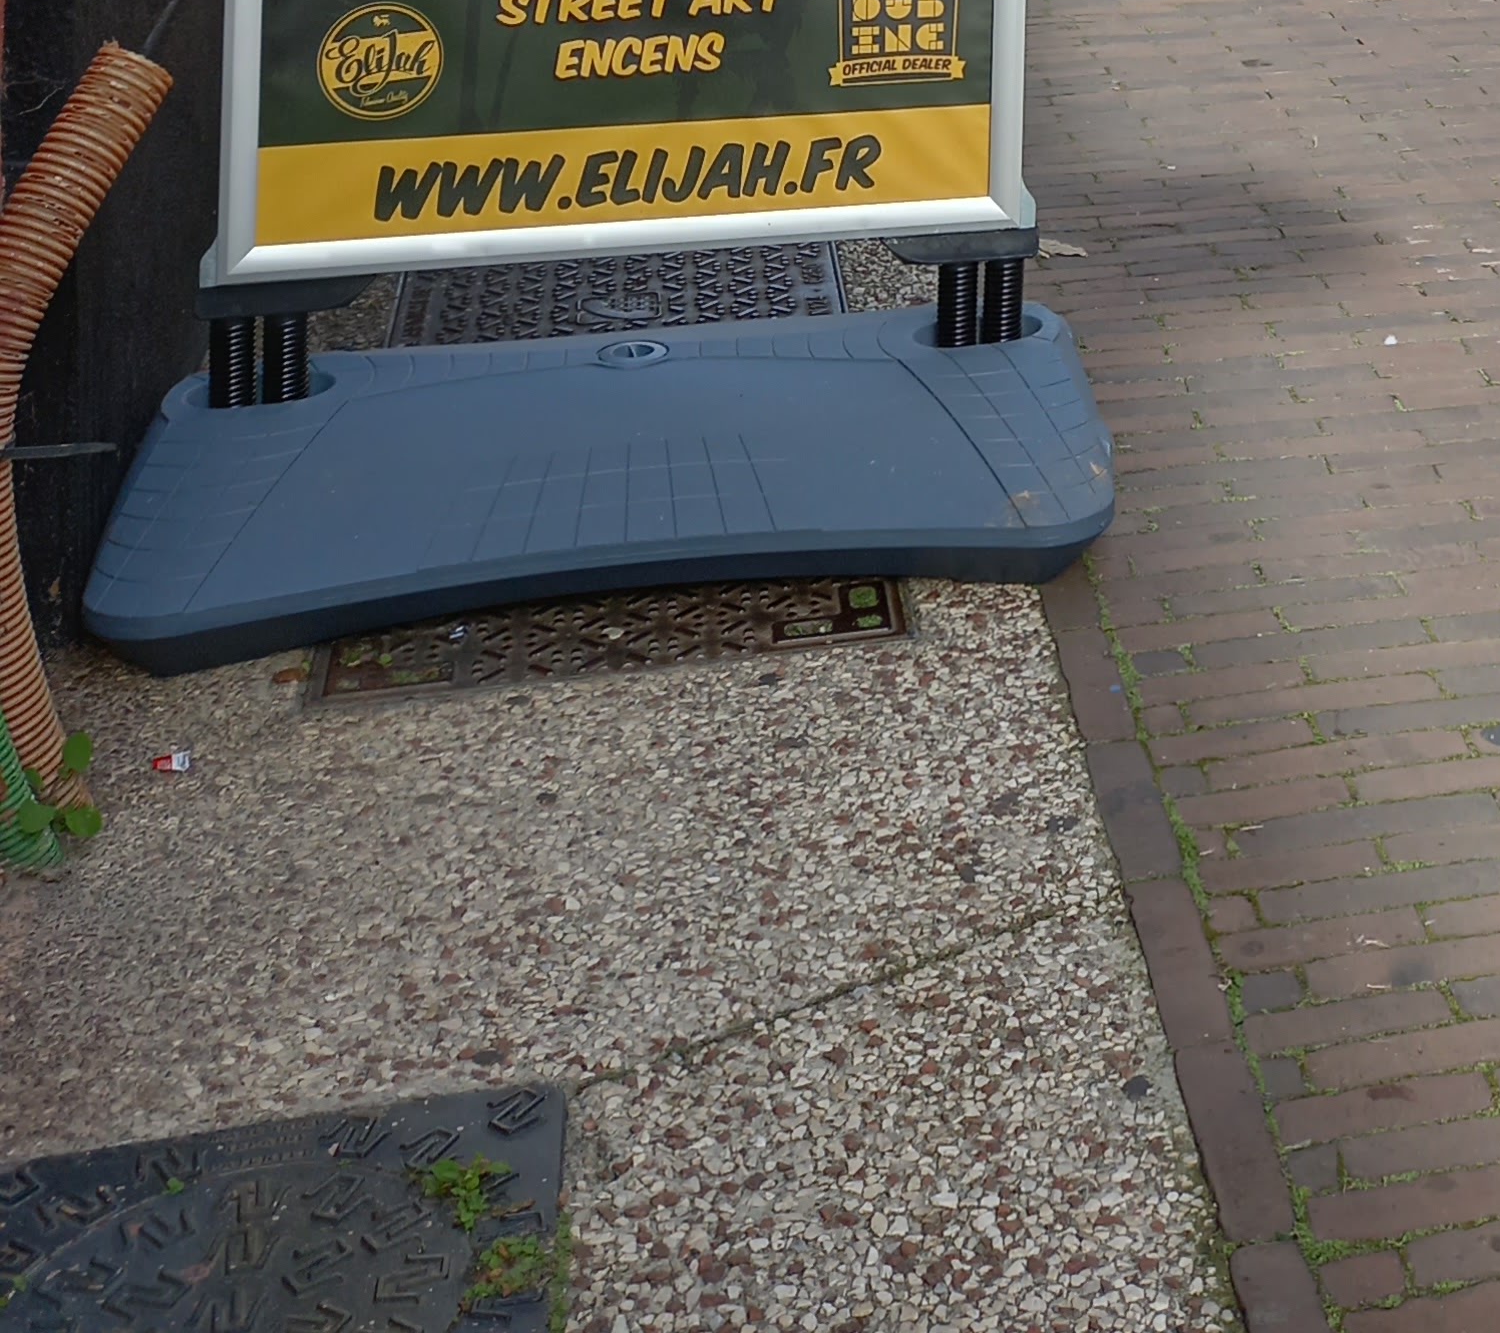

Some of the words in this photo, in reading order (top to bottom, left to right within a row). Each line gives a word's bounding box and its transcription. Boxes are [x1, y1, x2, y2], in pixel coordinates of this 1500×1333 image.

[554, 34, 724, 79] ENCENS
[842, 59, 897, 76] OFFICIAL
[902, 58, 952, 72] DEALER
[373, 135, 883, 222] WWW.ELIJAH.FR
